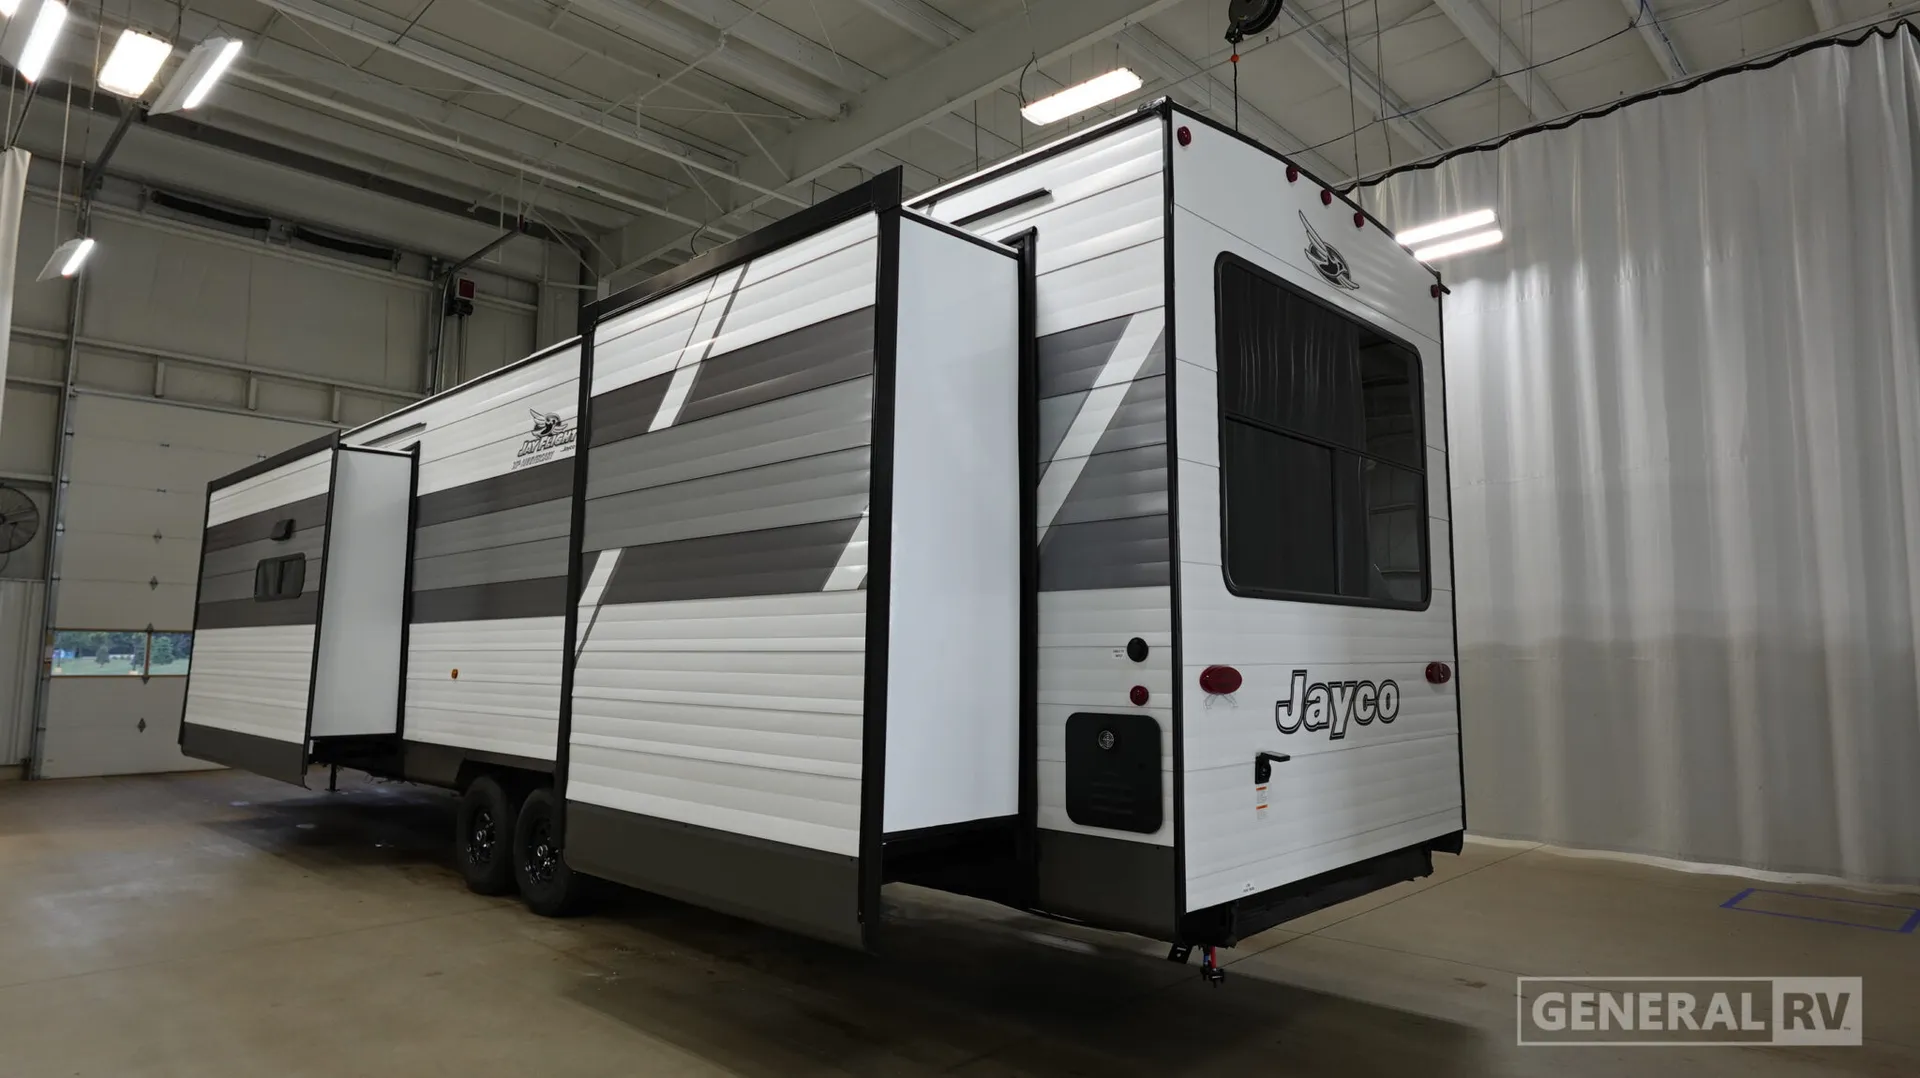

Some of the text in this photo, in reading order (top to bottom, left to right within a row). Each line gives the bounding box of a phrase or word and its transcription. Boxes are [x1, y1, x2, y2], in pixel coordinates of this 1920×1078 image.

[517, 428, 577, 457] JAY FLIGHT
[1275, 669, 1400, 740] Jayco
